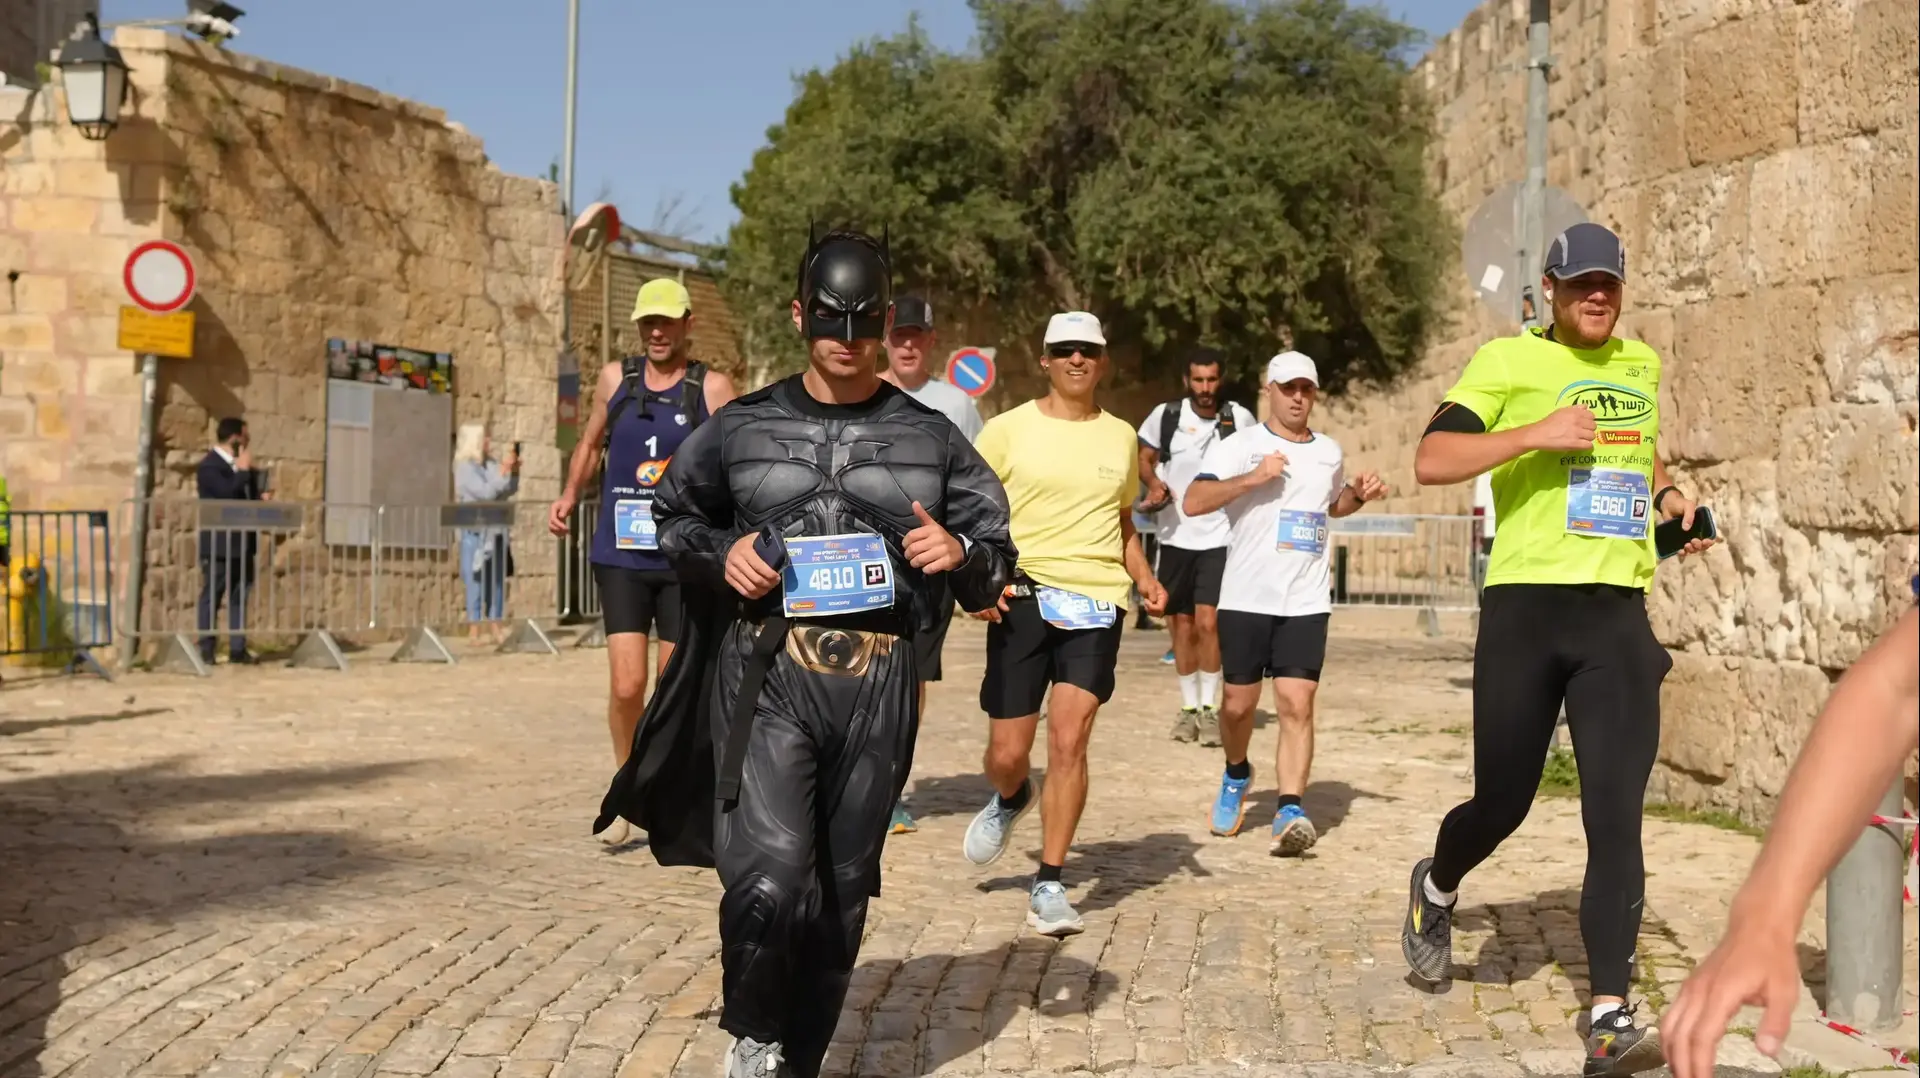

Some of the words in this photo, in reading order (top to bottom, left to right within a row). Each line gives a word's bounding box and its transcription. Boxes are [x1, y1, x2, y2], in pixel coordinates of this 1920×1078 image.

[1618, 400, 1645, 412] קשר
[1605, 432, 1639, 442] Winner
[644, 435, 657, 457] 1
[1560, 456, 1577, 466] EYE
[1578, 455, 1618, 465] CONTACT
[1590, 495, 1626, 517] 5060
[808, 566, 855, 591] 4810
[867, 594, 888, 603] 42.2
